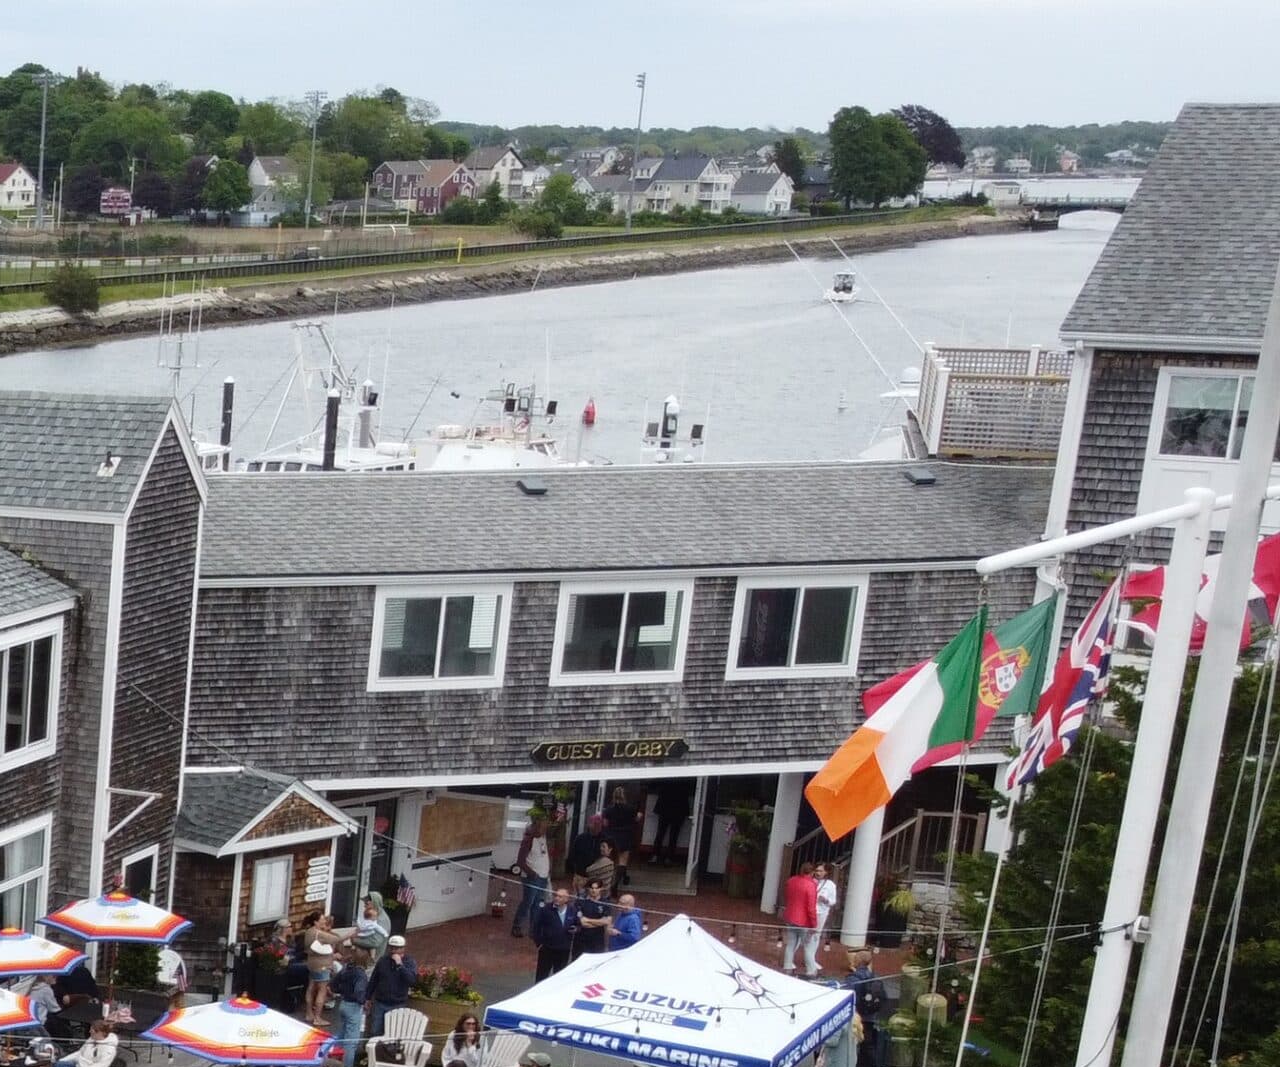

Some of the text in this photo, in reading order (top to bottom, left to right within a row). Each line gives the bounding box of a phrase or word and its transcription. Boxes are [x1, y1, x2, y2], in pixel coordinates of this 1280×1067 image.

[546, 741, 676, 760] GUEST LOBBY
[600, 1003, 675, 1026] MARINE
[611, 989, 719, 1016] SUZUKI
[518, 1020, 620, 1050] SUZUKI
